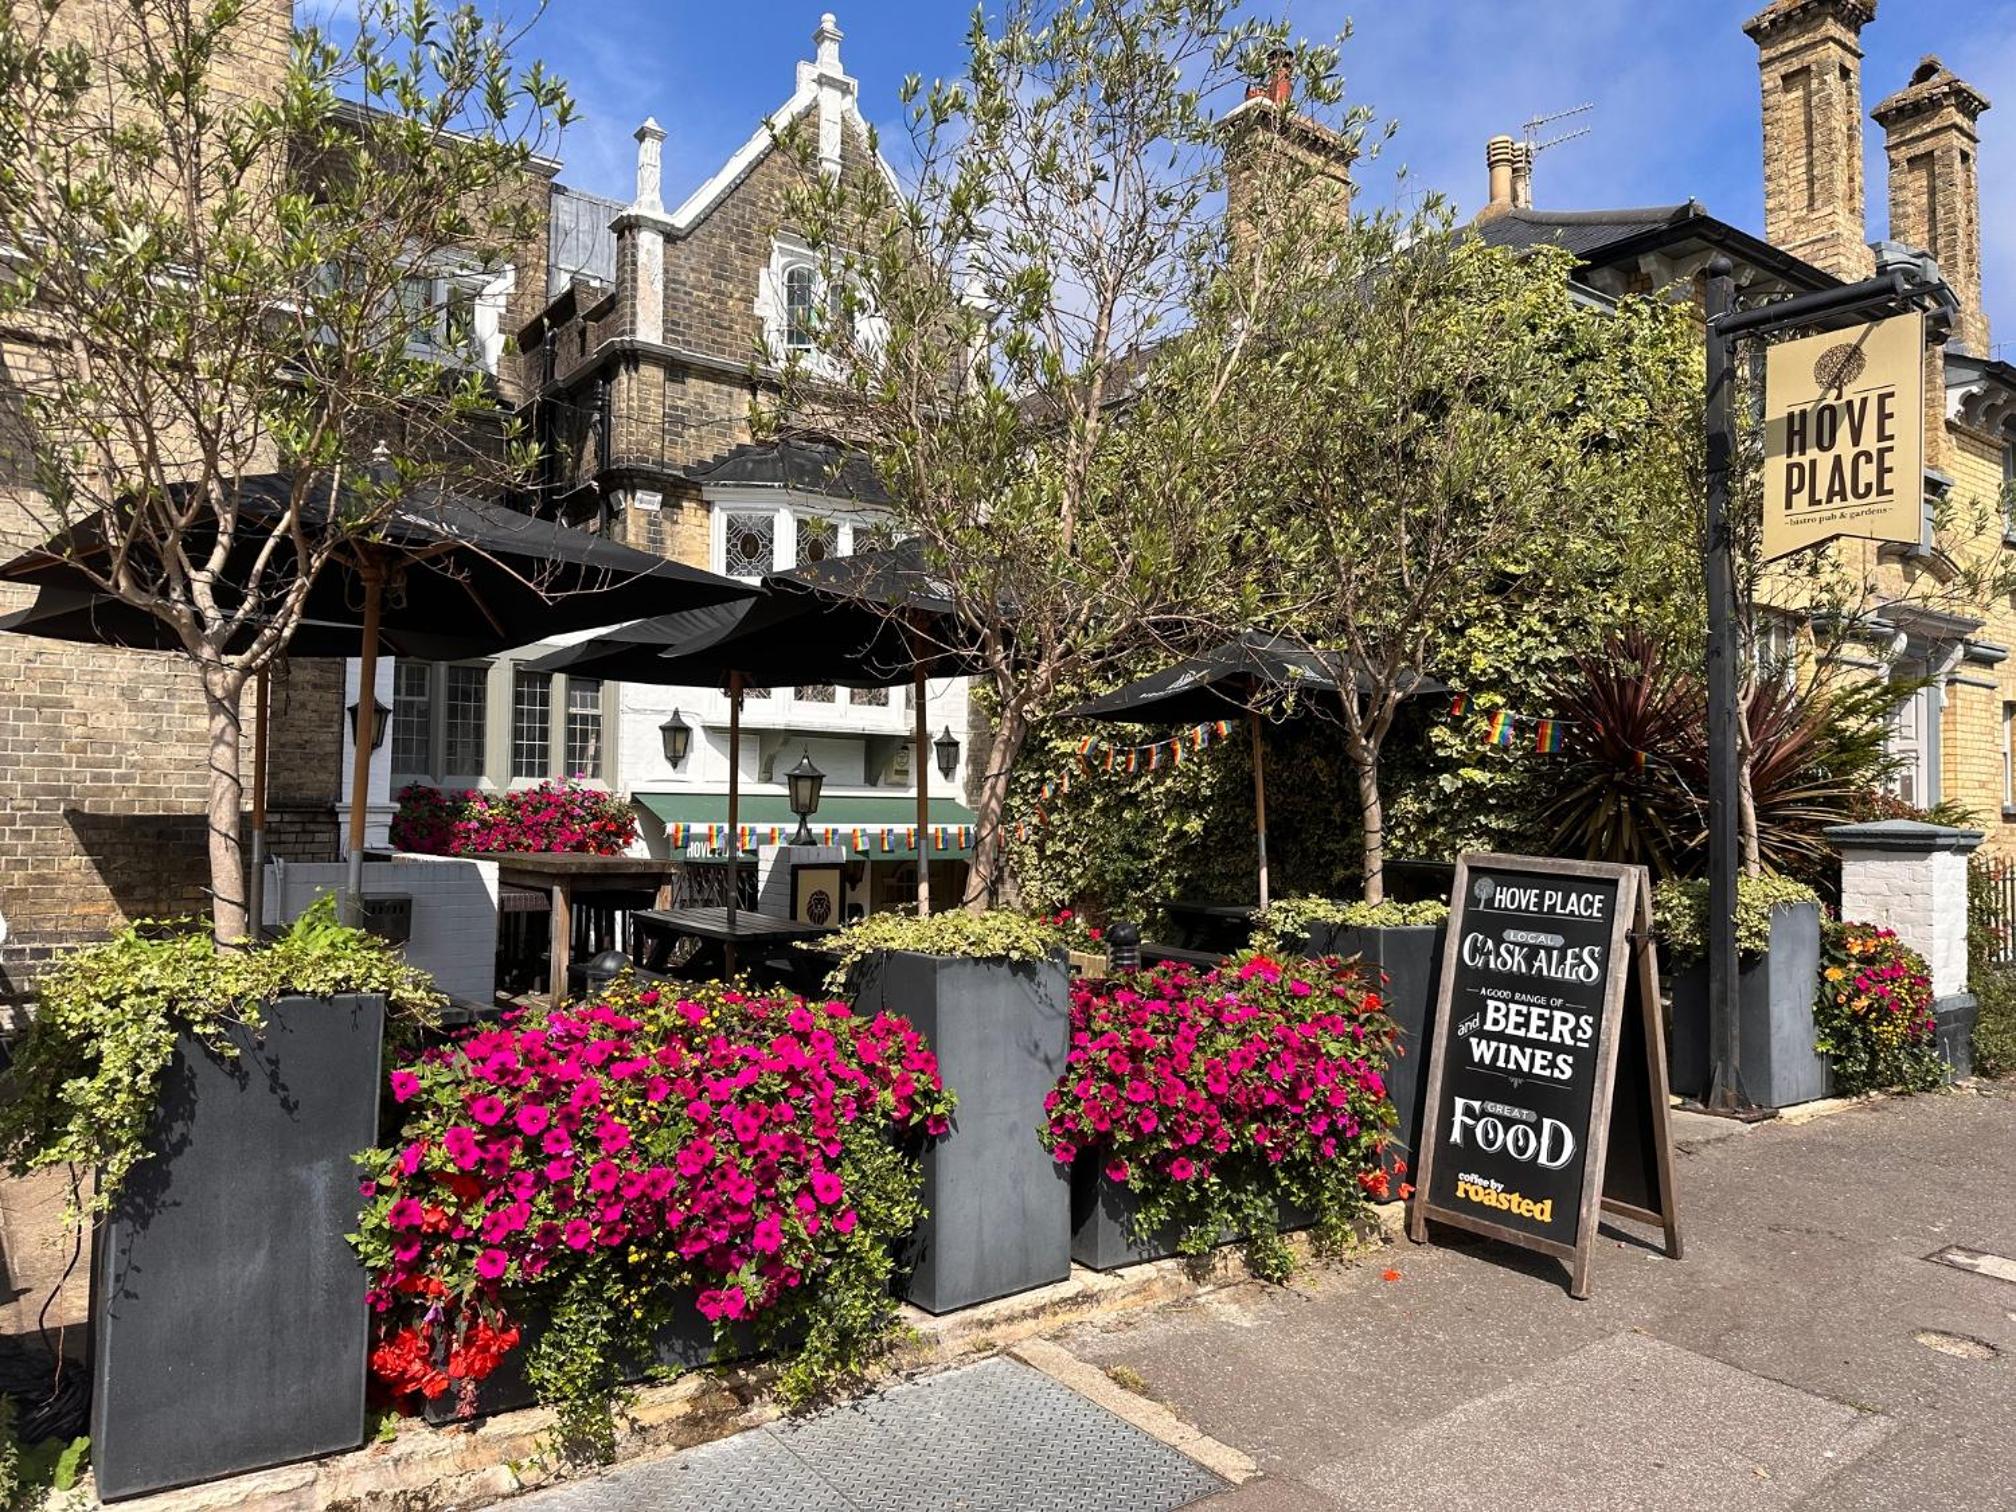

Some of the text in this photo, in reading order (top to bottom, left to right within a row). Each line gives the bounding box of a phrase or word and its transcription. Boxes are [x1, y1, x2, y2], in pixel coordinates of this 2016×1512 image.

[1786, 391, 1895, 459] HOVE
[1785, 446, 1894, 510] PLACE
[1819, 513, 1837, 524] pub
[1849, 508, 1888, 519] gardens
[1494, 886, 1605, 917] HOVE PLACE
[1510, 932, 1555, 945] LOCAL
[1462, 932, 1602, 984] CASK ALES
[1514, 992, 1547, 1005] RANGE
[1550, 998, 1564, 1007] OF
[1457, 1012, 1480, 1036] and
[1483, 999, 1593, 1046] BEERS
[1469, 1037, 1574, 1081] WINES
[1487, 1102, 1530, 1120] GREAT
[1449, 1096, 1577, 1170] FOOD
[1458, 1172, 1505, 1192] coffee by
[1455, 1181, 1553, 1223] roasted
